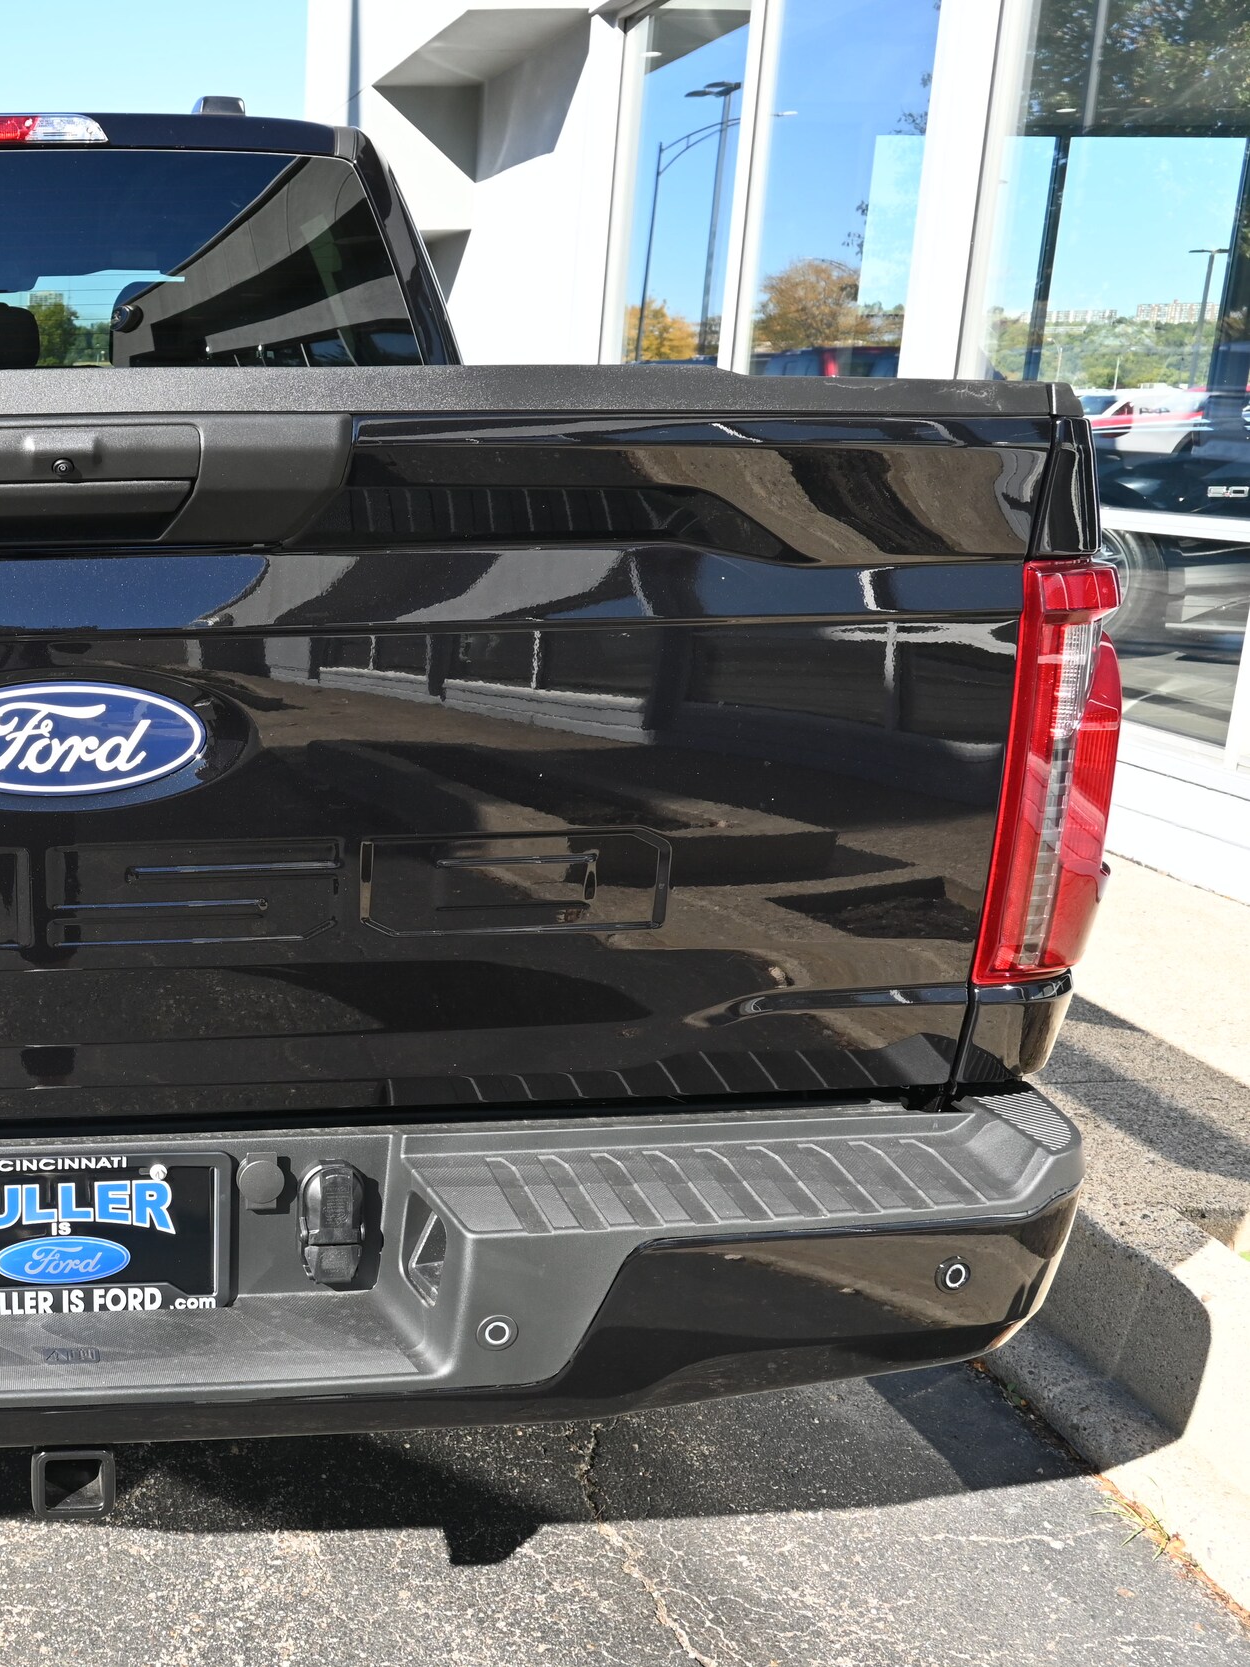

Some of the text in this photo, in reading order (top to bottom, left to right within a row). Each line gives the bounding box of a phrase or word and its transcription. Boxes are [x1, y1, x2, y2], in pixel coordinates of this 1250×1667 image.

[50, 1221, 72, 1236] IS
[23, 1245, 103, 1275] Ford
[61, 1289, 87, 1314] IS
[92, 1286, 163, 1312] FORD
